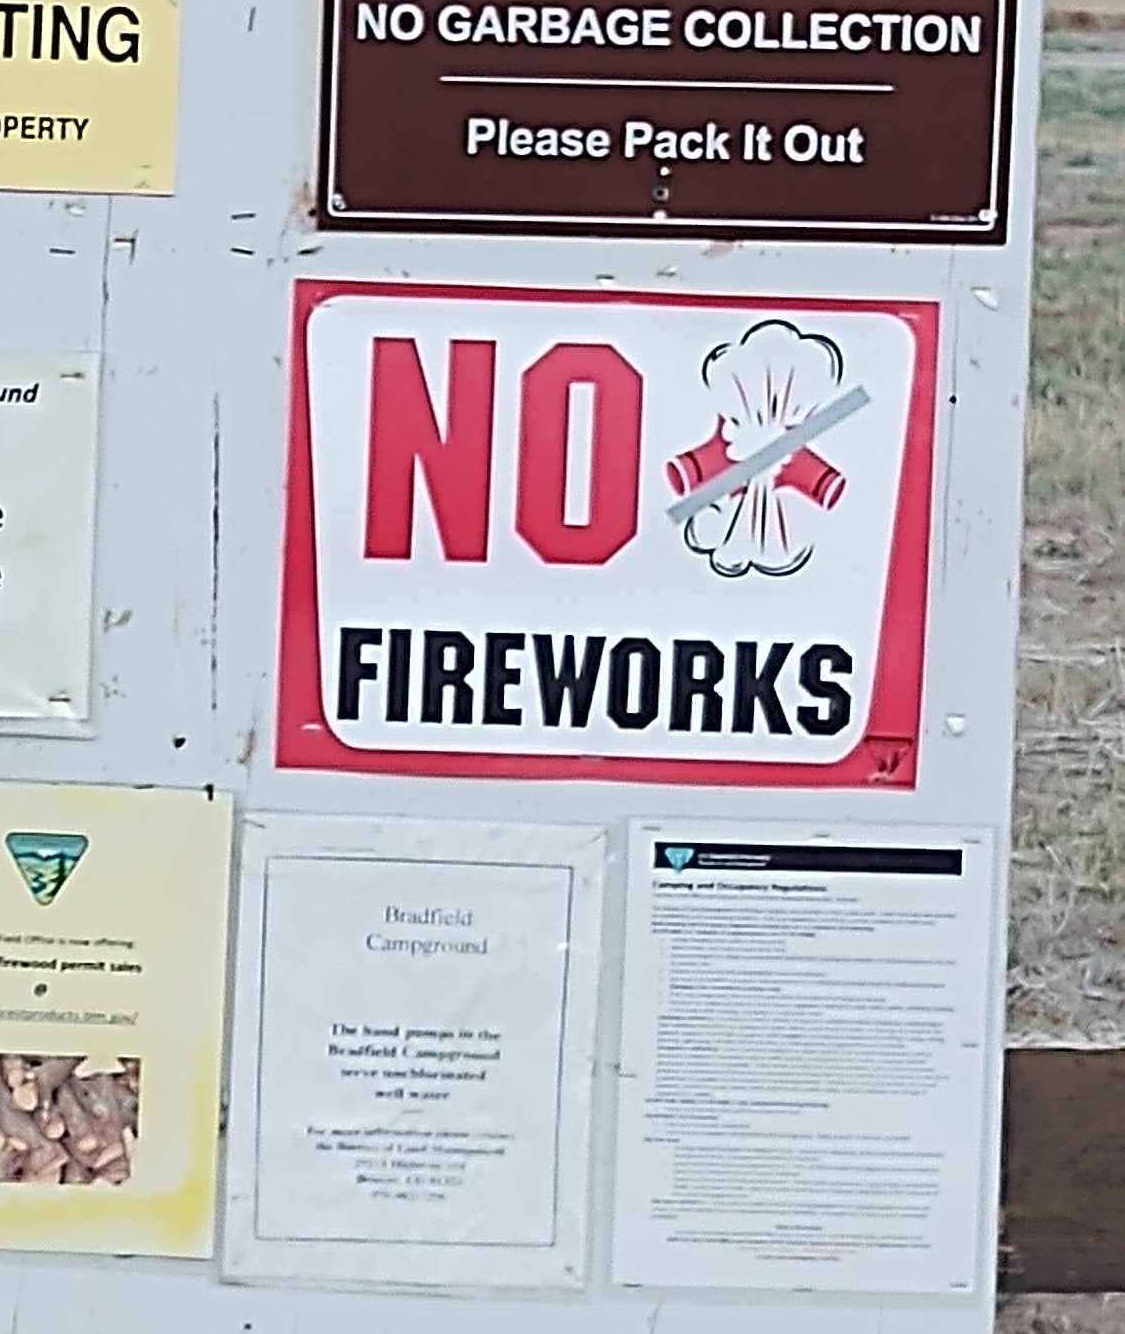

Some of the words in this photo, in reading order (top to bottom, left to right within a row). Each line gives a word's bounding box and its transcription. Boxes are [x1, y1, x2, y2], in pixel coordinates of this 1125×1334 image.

[356, 4, 424, 42] NO
[437, 6, 672, 47] GARBAGE
[684, 10, 982, 54] COLLECTION
[467, 119, 612, 158] Please
[624, 122, 729, 160] Pack
[743, 126, 772, 161] It
[784, 126, 865, 164] Out
[364, 336, 644, 565] NO
[336, 627, 853, 735] FIREWORKS
[384, 905, 474, 928] Bradfield
[365, 934, 488, 957] Campground
[60, 962, 105, 972] permit
[110, 963, 142, 973] sales
[34, 983, 48, 996] @
[332, 1023, 357, 1036] The
[329, 1045, 397, 1057] Bradfield
[402, 1047, 500, 1061] Campground
